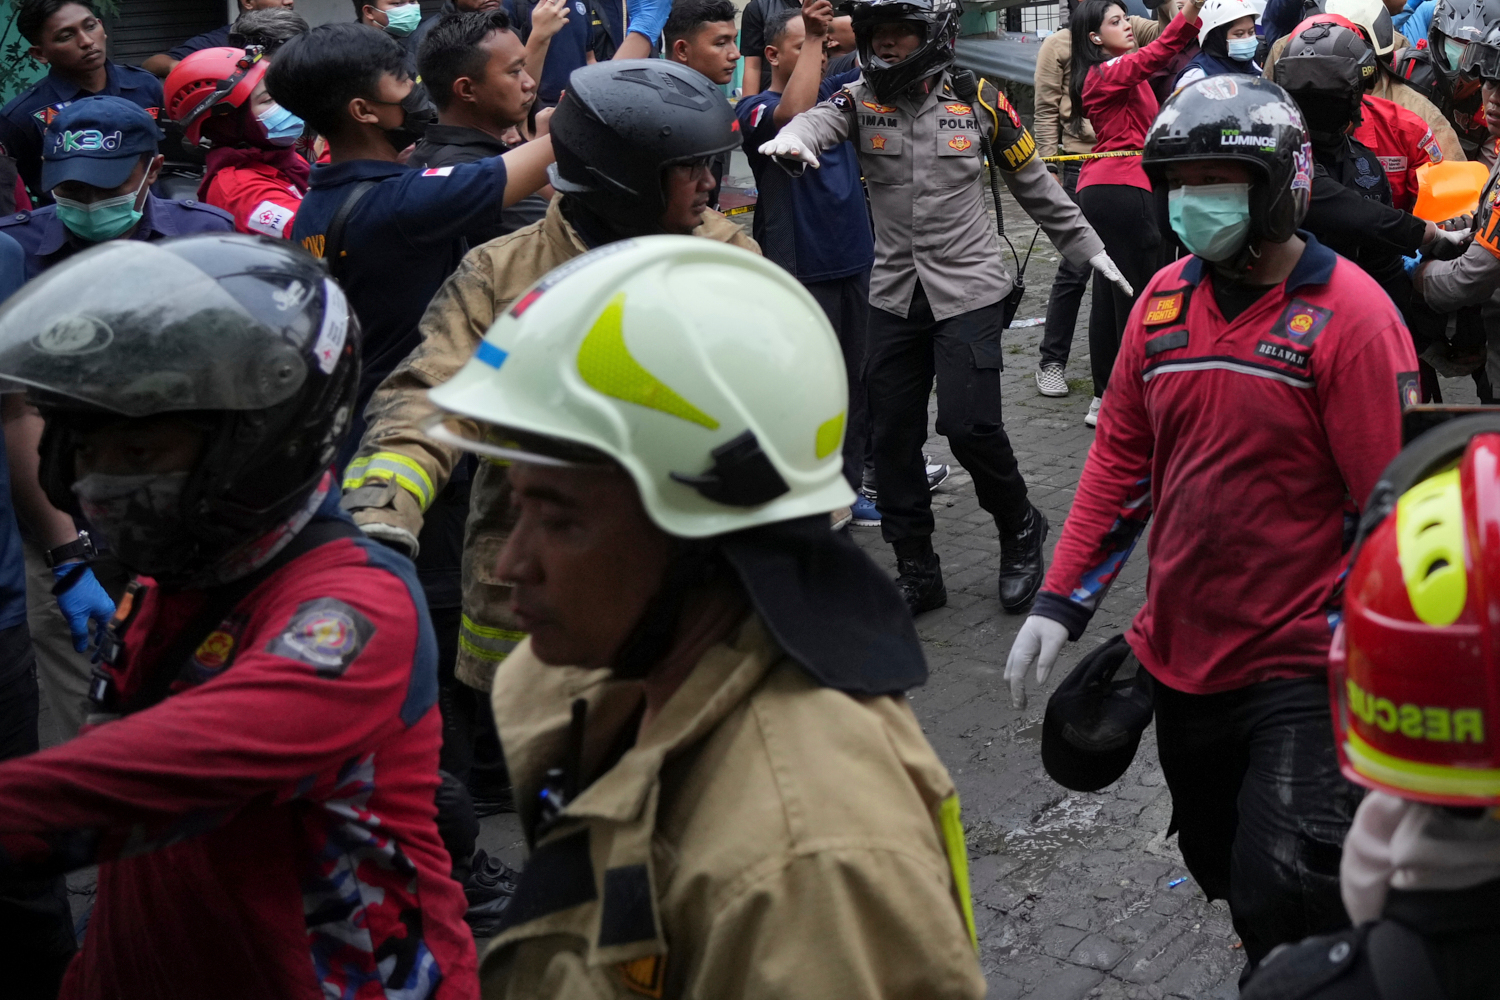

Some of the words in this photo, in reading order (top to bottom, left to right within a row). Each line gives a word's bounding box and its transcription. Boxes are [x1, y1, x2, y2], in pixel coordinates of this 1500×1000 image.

[861, 115, 898, 128] IMAM
[1003, 126, 1036, 168] PAMA
[1221, 135, 1276, 147] LUMINOS
[270, 214, 283, 230] PMI
[1157, 298, 1175, 311] FIRE
[1147, 307, 1178, 321] FIGHTER
[1259, 344, 1305, 365] RELAWAN
